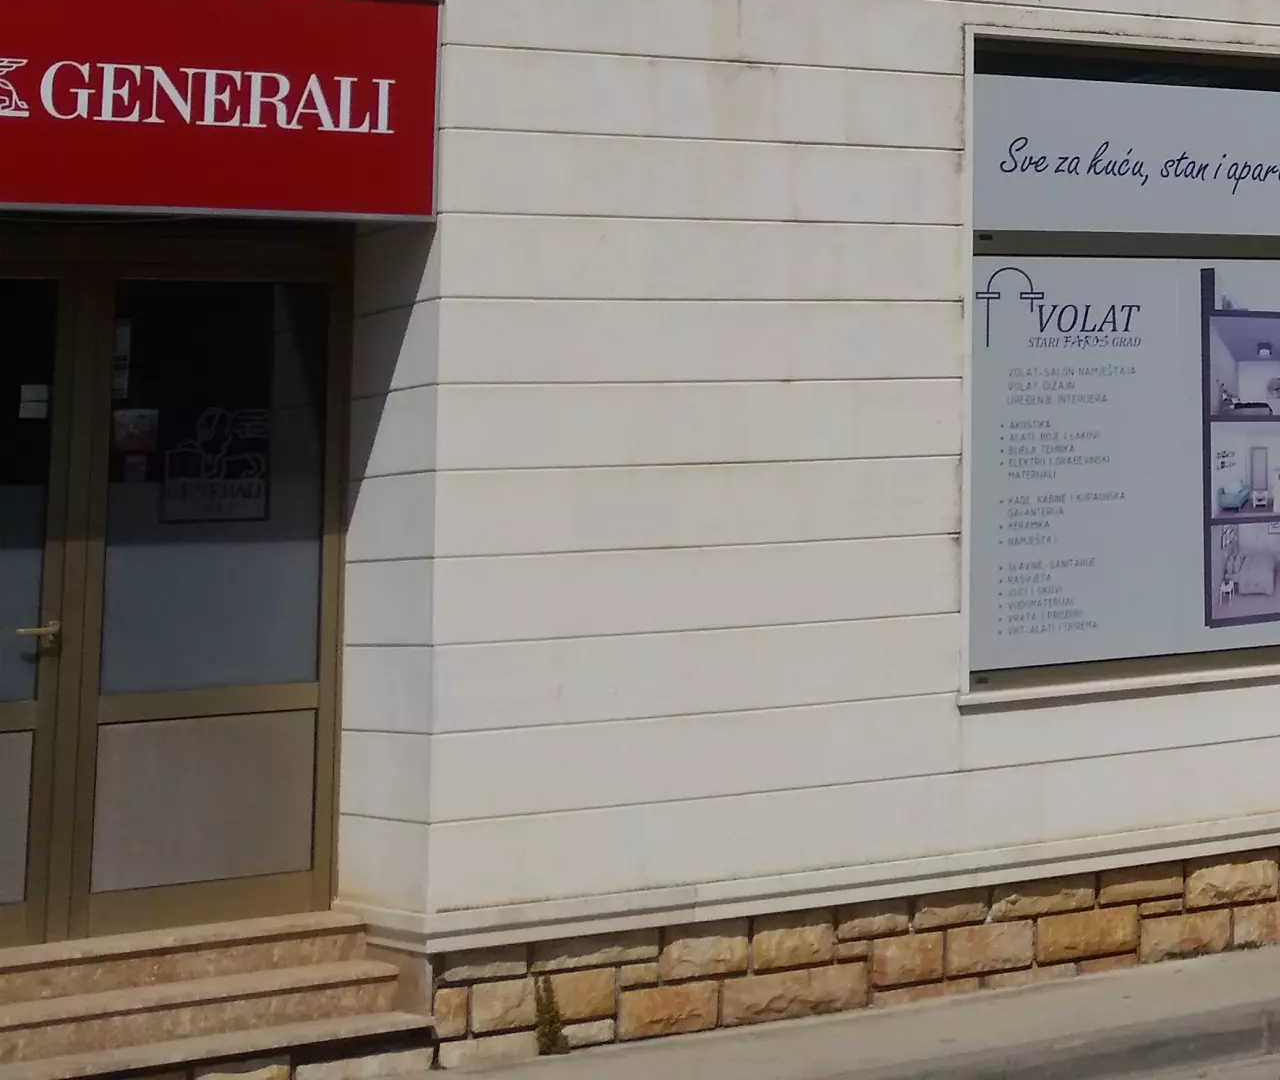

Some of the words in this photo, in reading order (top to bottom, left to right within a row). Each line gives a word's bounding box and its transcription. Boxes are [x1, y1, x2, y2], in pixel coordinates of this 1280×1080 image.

[39, 60, 396, 134] GENERALI
[1000, 136, 1048, 174] Sve
[1054, 151, 1080, 175] za
[1086, 140, 1150, 187] kuću,
[1160, 150, 1207, 182] stan
[1213, 154, 1226, 181] i
[1038, 304, 1141, 333] VOLAT
[1027, 336, 1060, 348] STARI
[1111, 336, 1142, 348] GRAD
